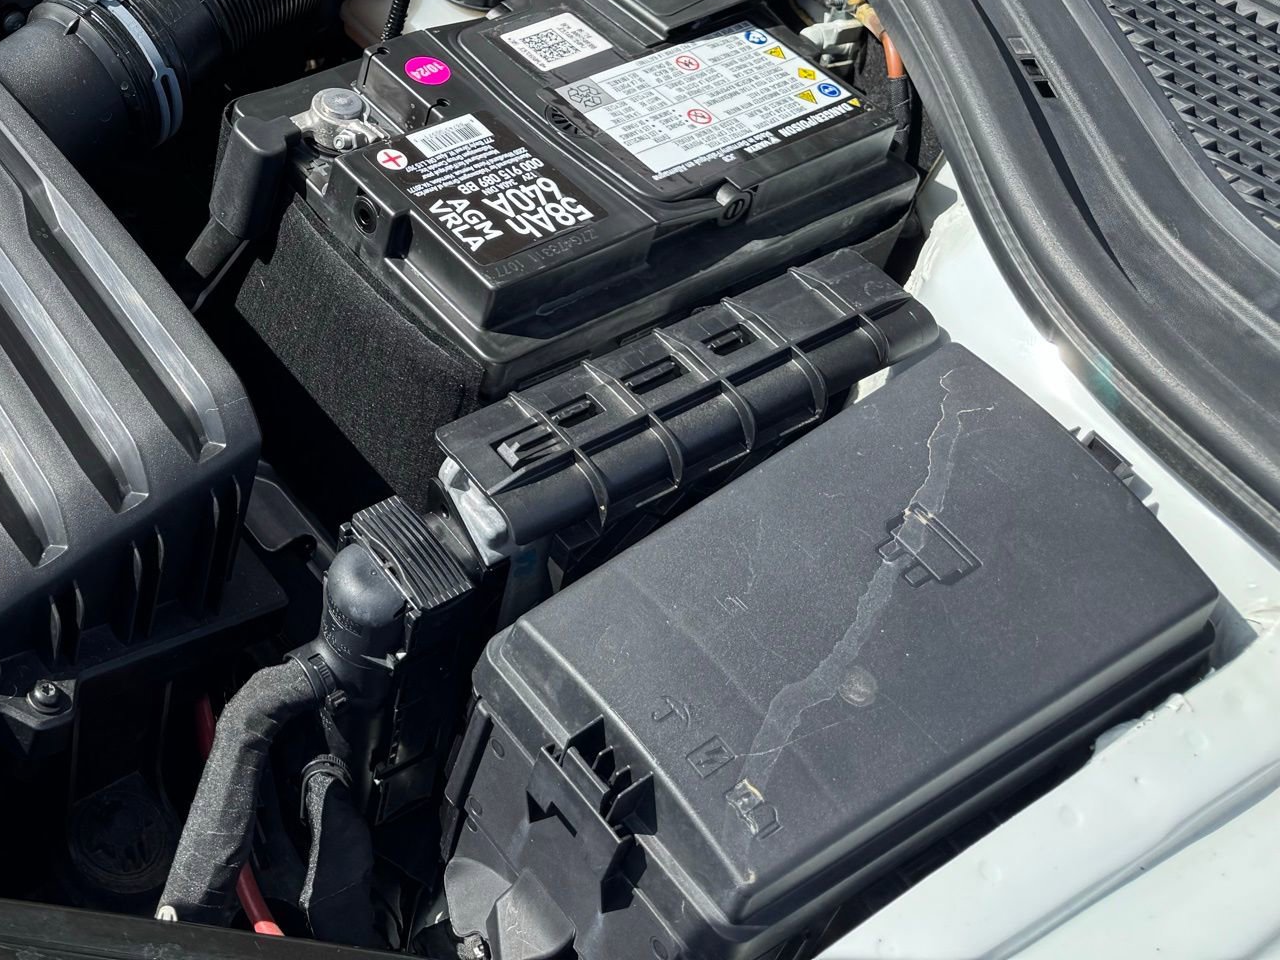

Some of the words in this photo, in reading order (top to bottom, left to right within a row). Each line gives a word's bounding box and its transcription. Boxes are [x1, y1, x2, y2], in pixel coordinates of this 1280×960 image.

[410, 62, 444, 80] 10/24
[777, 102, 853, 137] DANGER/POISON
[743, 139, 772, 153] VARTA
[518, 157, 544, 171] 000
[477, 172, 501, 187] 089
[497, 165, 523, 180] 915
[521, 171, 537, 181] 12V
[456, 180, 480, 194] BB
[480, 185, 499, 196] DIN
[481, 176, 561, 218] 640A
[445, 198, 503, 240] AGM
[506, 196, 593, 237] 58Ah
[428, 198, 484, 251] VRLA
